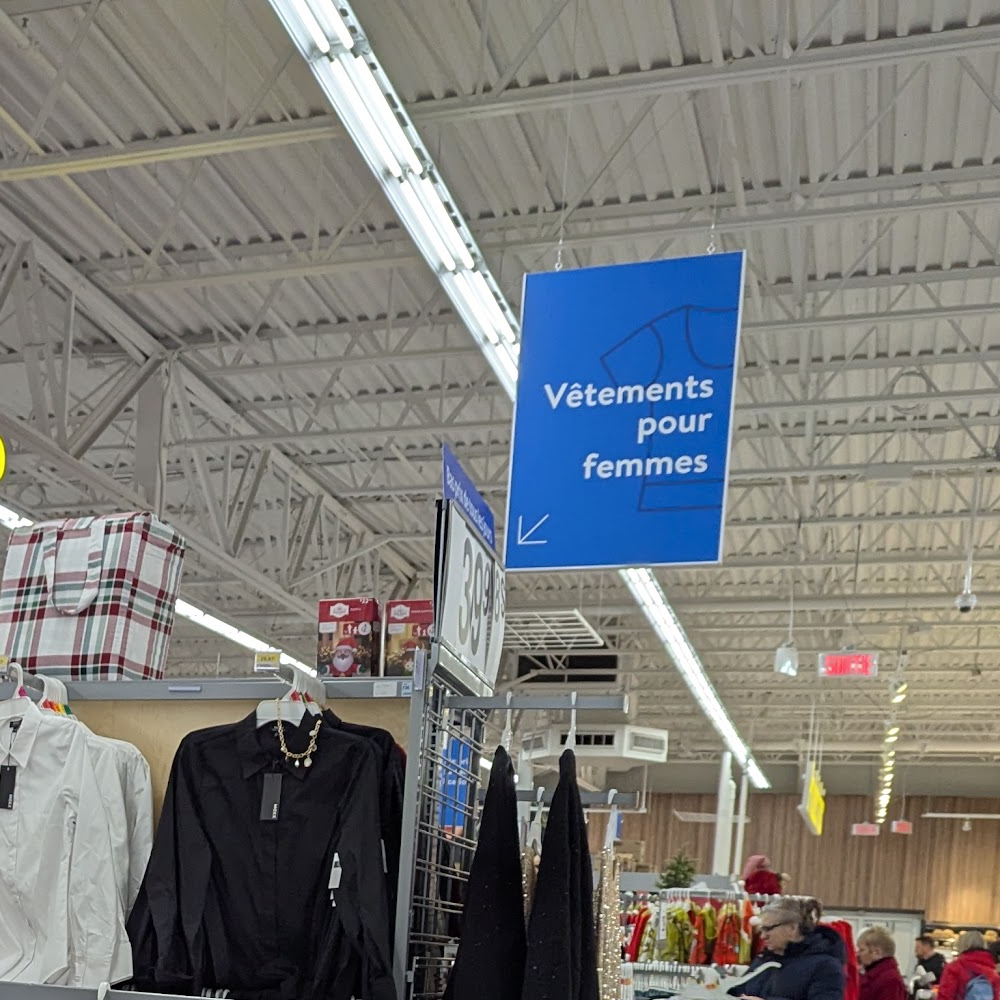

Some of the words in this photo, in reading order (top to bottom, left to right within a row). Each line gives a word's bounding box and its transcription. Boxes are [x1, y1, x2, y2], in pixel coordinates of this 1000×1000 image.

[544, 376, 714, 410] Vêtements
[637, 411, 713, 444] pour
[583, 452, 709, 480] femmes
